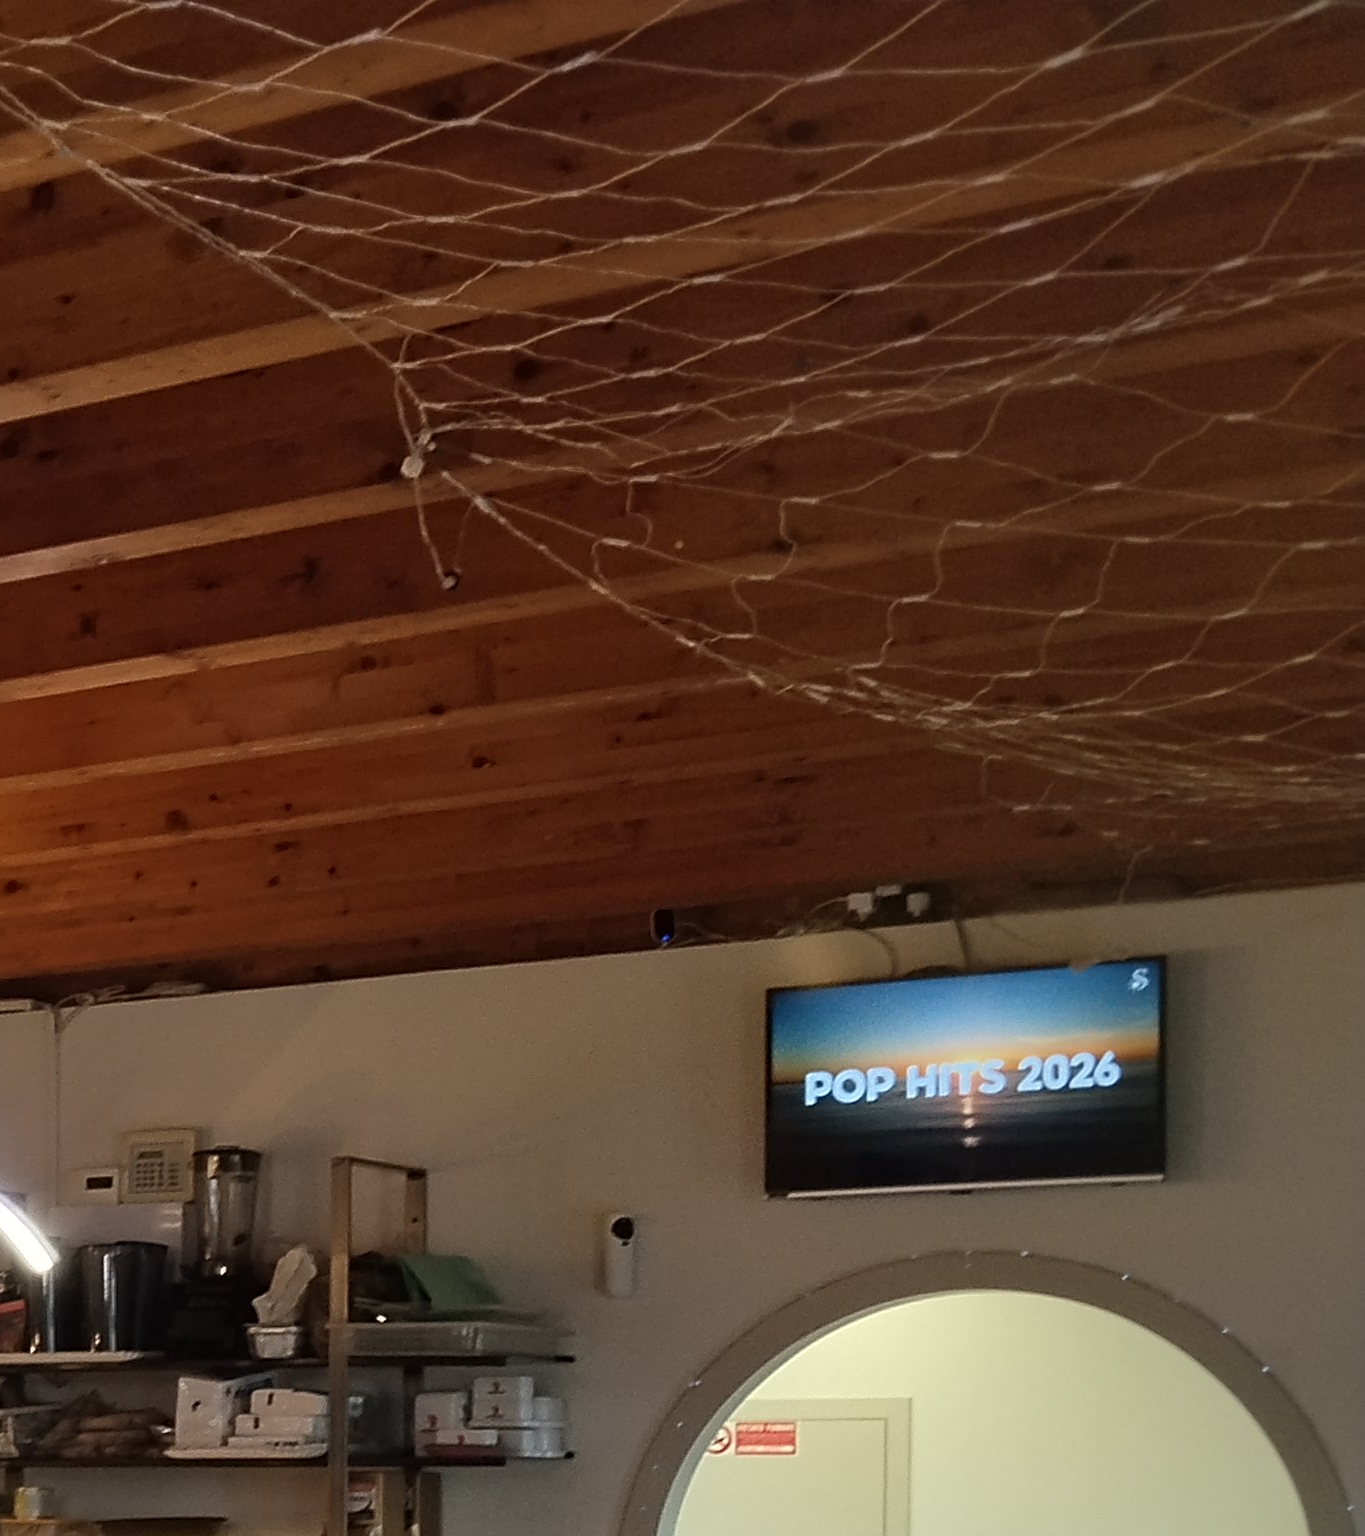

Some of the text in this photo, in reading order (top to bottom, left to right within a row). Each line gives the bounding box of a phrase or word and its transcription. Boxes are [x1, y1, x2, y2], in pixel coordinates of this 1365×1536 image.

[804, 1050, 1123, 1107] POP HITS 2026
